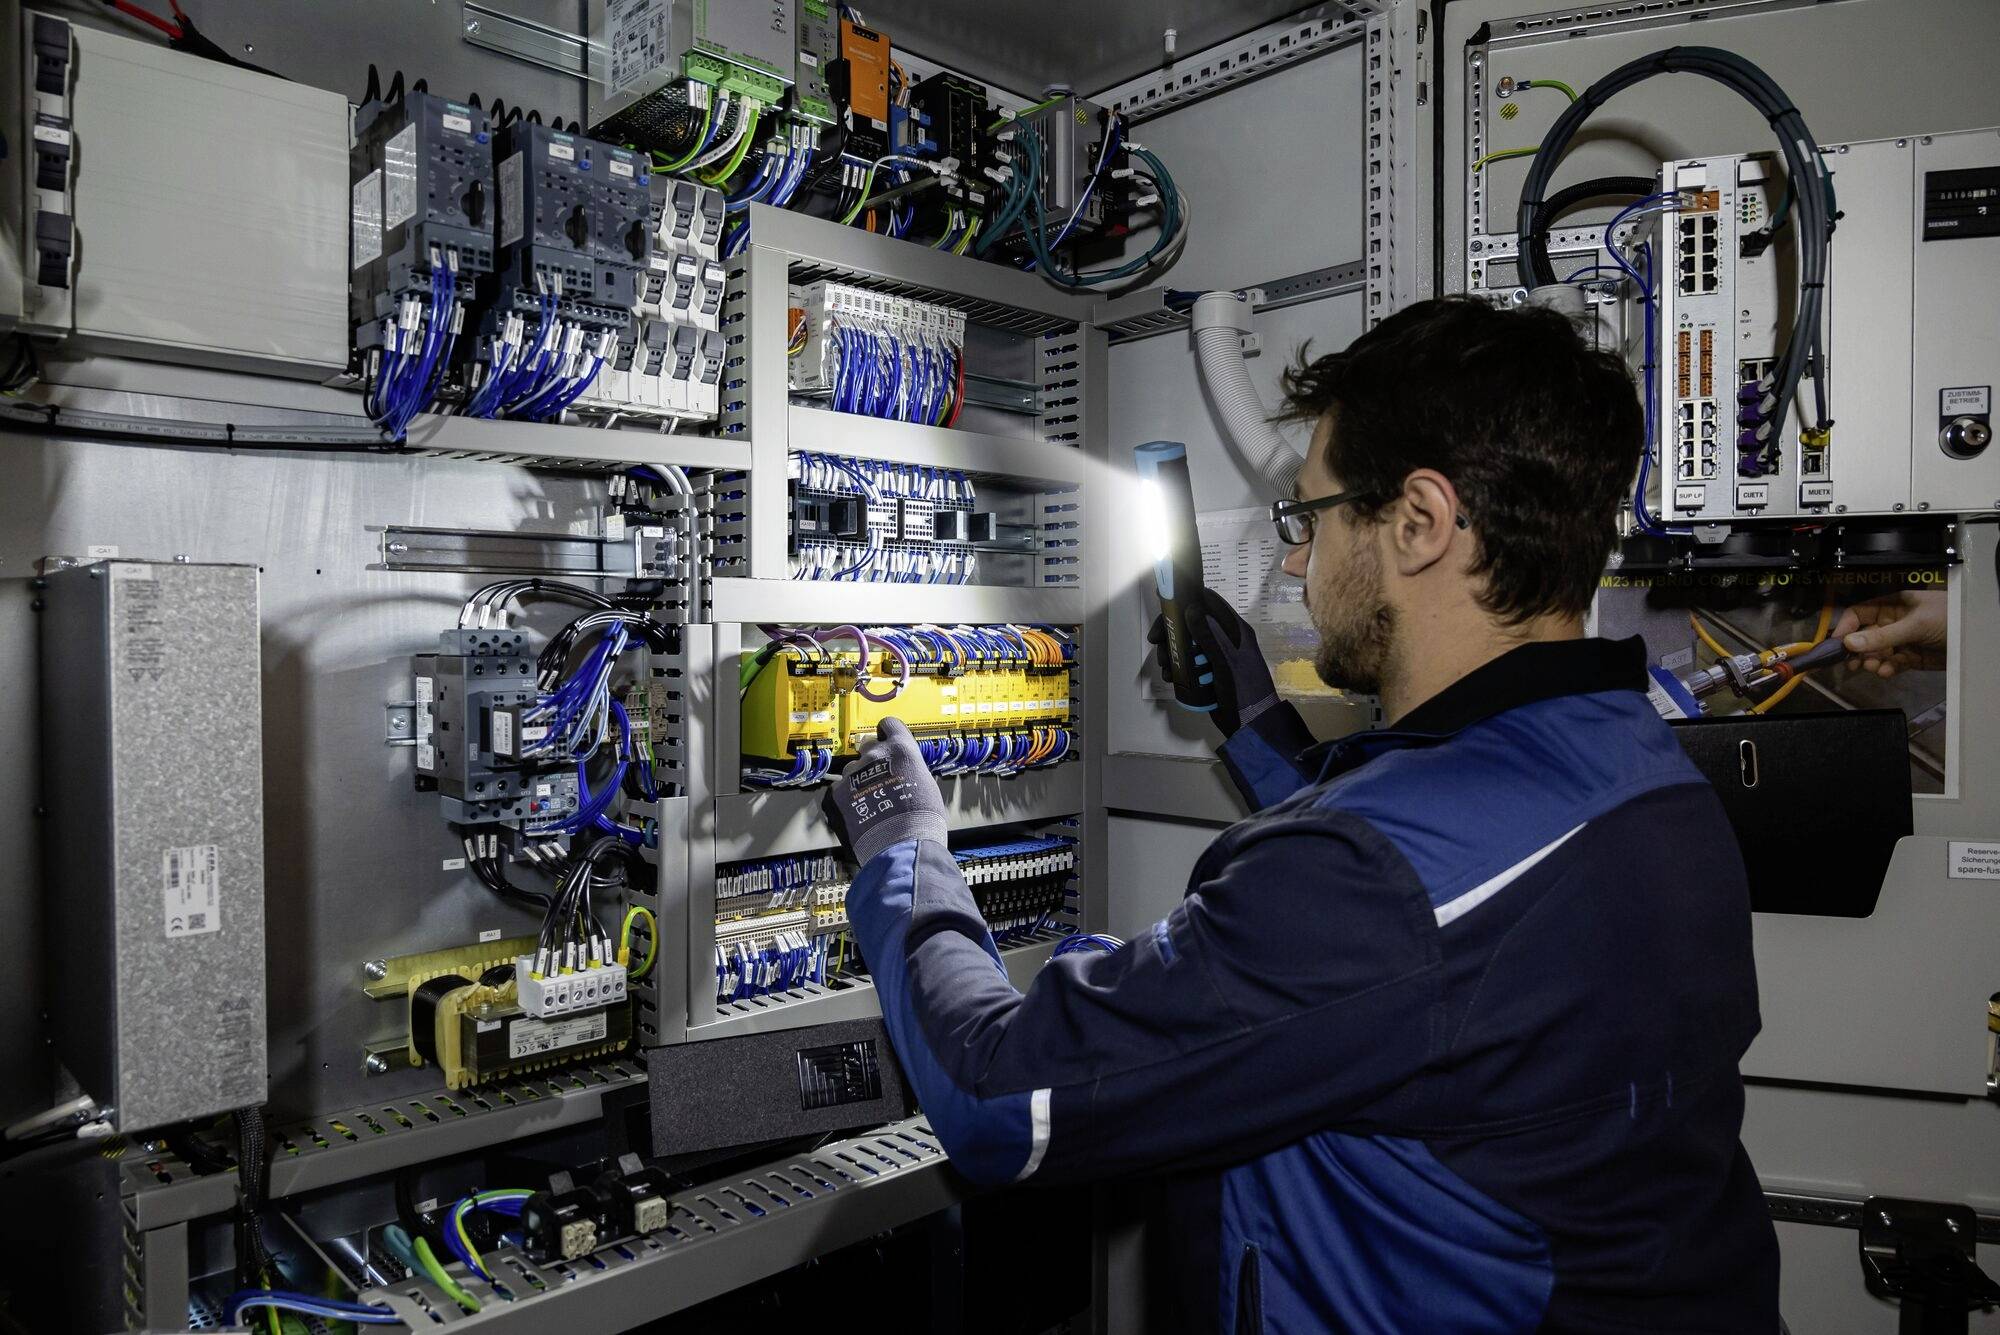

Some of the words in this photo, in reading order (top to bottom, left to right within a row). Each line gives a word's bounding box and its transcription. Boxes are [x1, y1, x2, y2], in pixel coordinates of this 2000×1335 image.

[1928, 220, 1958, 228] SIEMENS
[1600, 575, 1629, 588] M23
[1818, 571, 1893, 585] WRENCH
[1895, 571, 1944, 584] TOOL
[852, 762, 888, 787] HAZET
[1967, 847, 2000, 855] Reserve-
